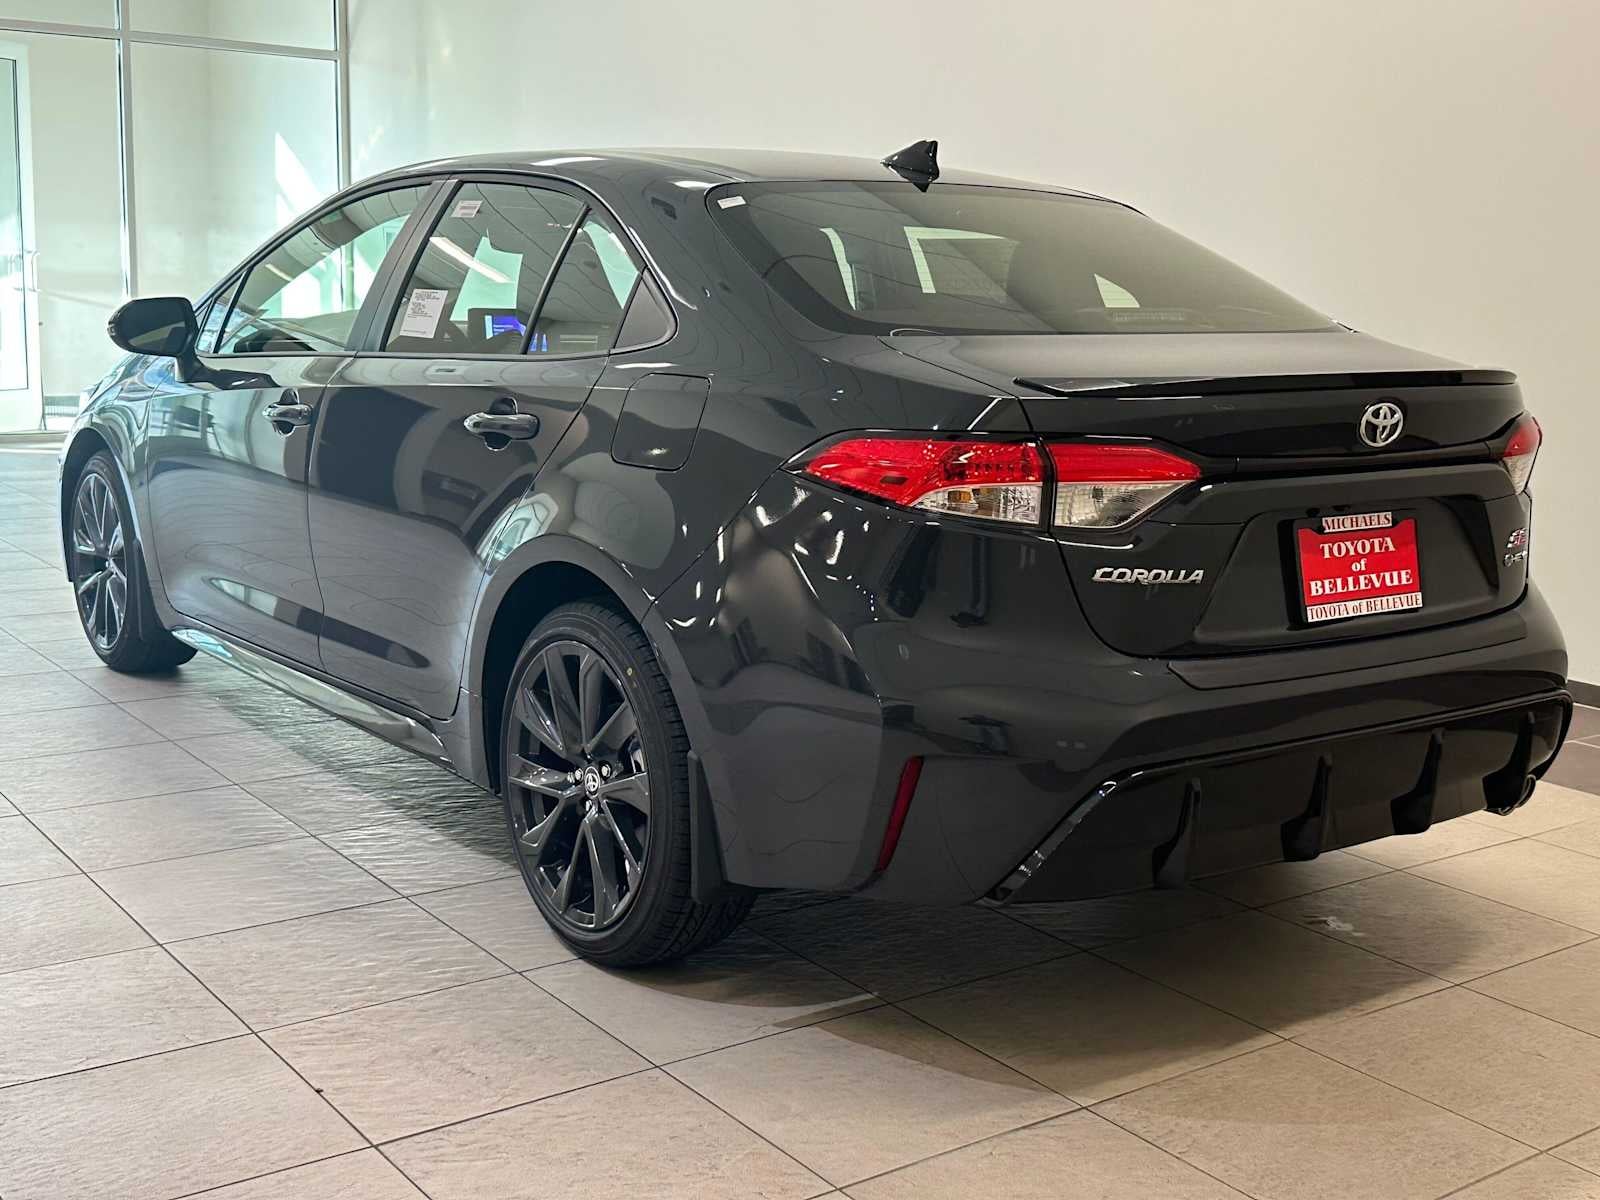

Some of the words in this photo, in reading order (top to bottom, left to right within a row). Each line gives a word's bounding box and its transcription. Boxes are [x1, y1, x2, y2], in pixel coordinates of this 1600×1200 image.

[1324, 513, 1391, 530] MICHAELS
[1320, 537, 1395, 558] TOYOTA
[1351, 558, 1367, 572] of
[1092, 567, 1204, 584] COROLLA
[1310, 569, 1413, 596] BELLEVUE
[1309, 603, 1351, 620] TOYOTA
[1352, 602, 1363, 614] of
[1366, 594, 1422, 612] BELLEVUE
